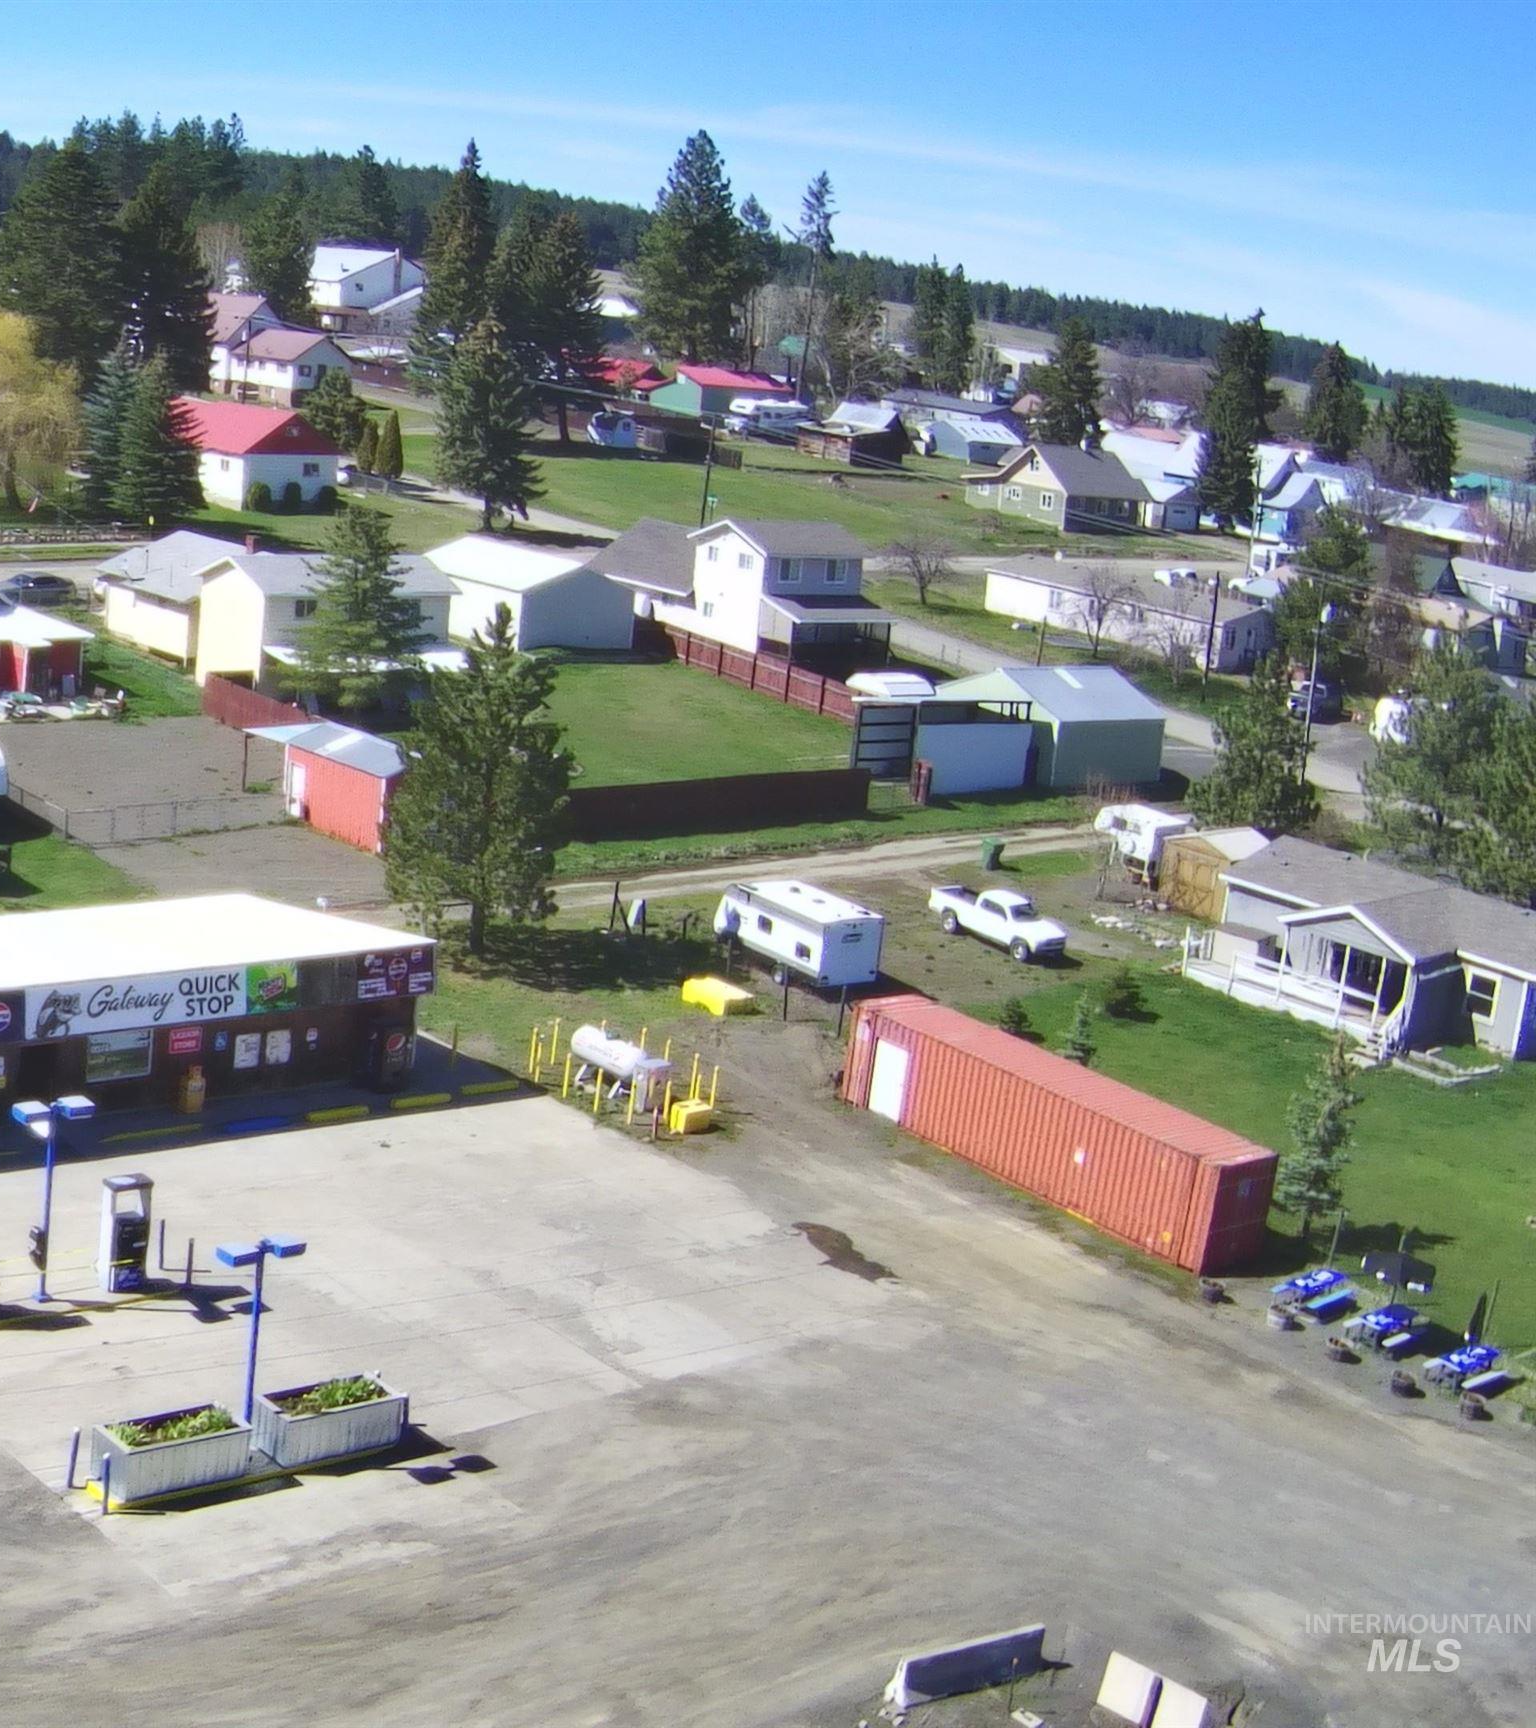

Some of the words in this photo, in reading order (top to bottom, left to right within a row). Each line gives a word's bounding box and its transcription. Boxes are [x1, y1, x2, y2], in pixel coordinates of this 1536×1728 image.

[178, 972, 241, 997] QUICK
[86, 984, 174, 1022] Gateway
[185, 995, 235, 1018] STOP
